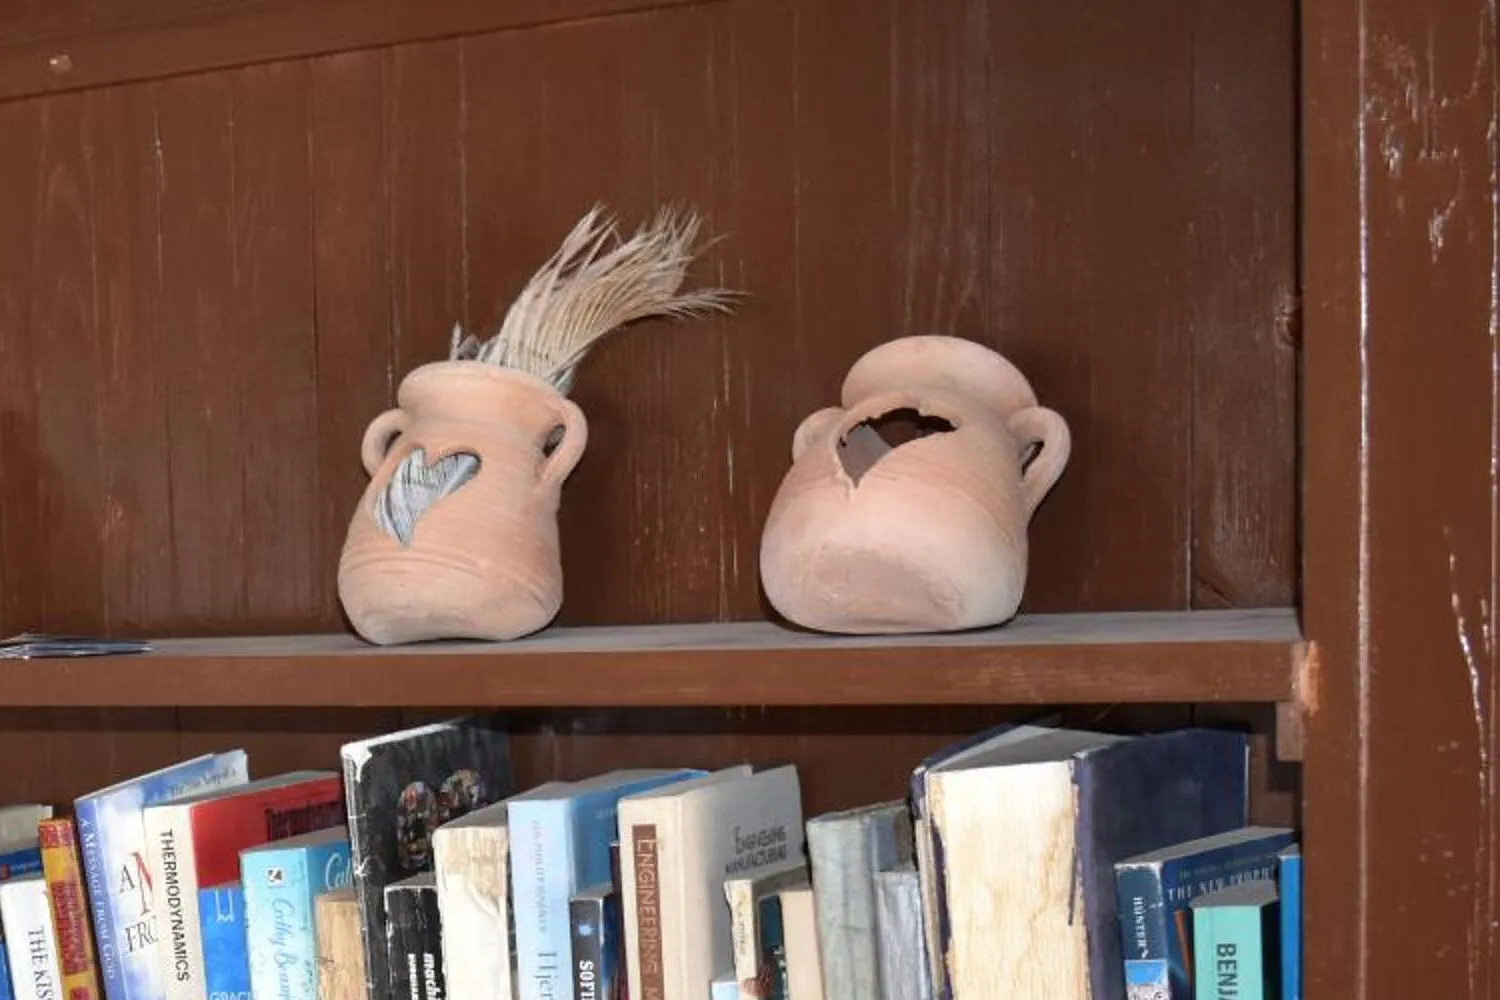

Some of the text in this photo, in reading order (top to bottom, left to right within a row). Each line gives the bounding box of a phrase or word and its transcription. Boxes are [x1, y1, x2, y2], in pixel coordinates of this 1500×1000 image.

[83, 832, 102, 896] MESSAGE
[93, 899, 108, 941] FROM
[101, 943, 116, 980] GOD
[159, 829, 190, 983] THERMODYNAMICS
[271, 899, 296, 948] Cathy
[635, 838, 662, 972] ENGINEERING
[1166, 886, 1192, 902] THE
[27, 927, 47, 964] THE
